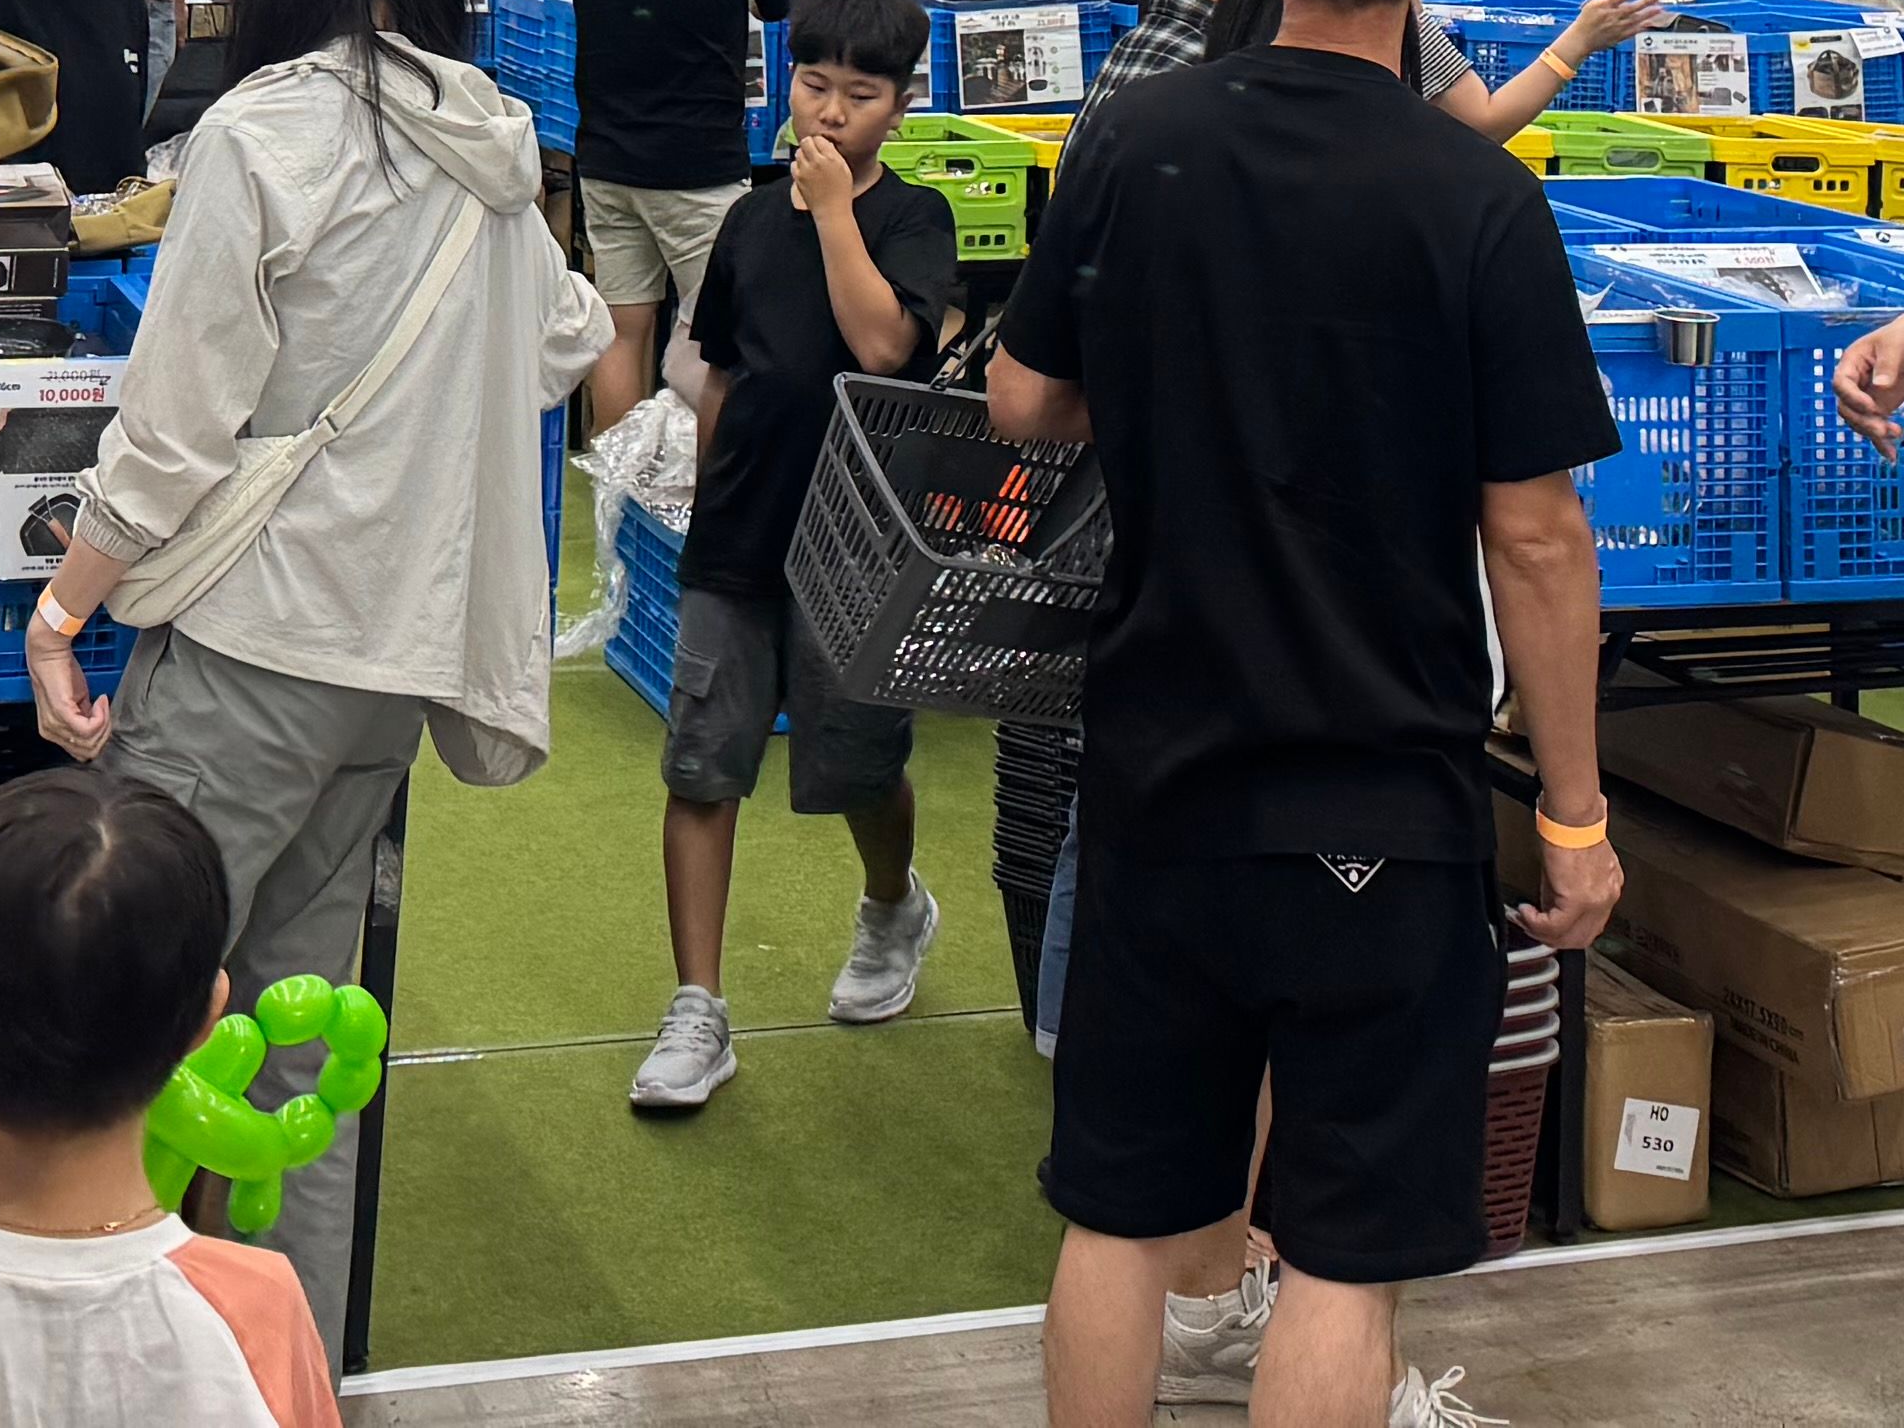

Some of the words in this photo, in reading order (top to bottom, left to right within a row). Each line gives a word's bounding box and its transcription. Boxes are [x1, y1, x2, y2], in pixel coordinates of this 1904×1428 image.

[39, 387, 105, 404] 10,000원
[1650, 1105, 1670, 1122] HO
[1641, 1135, 1675, 1153] 530
